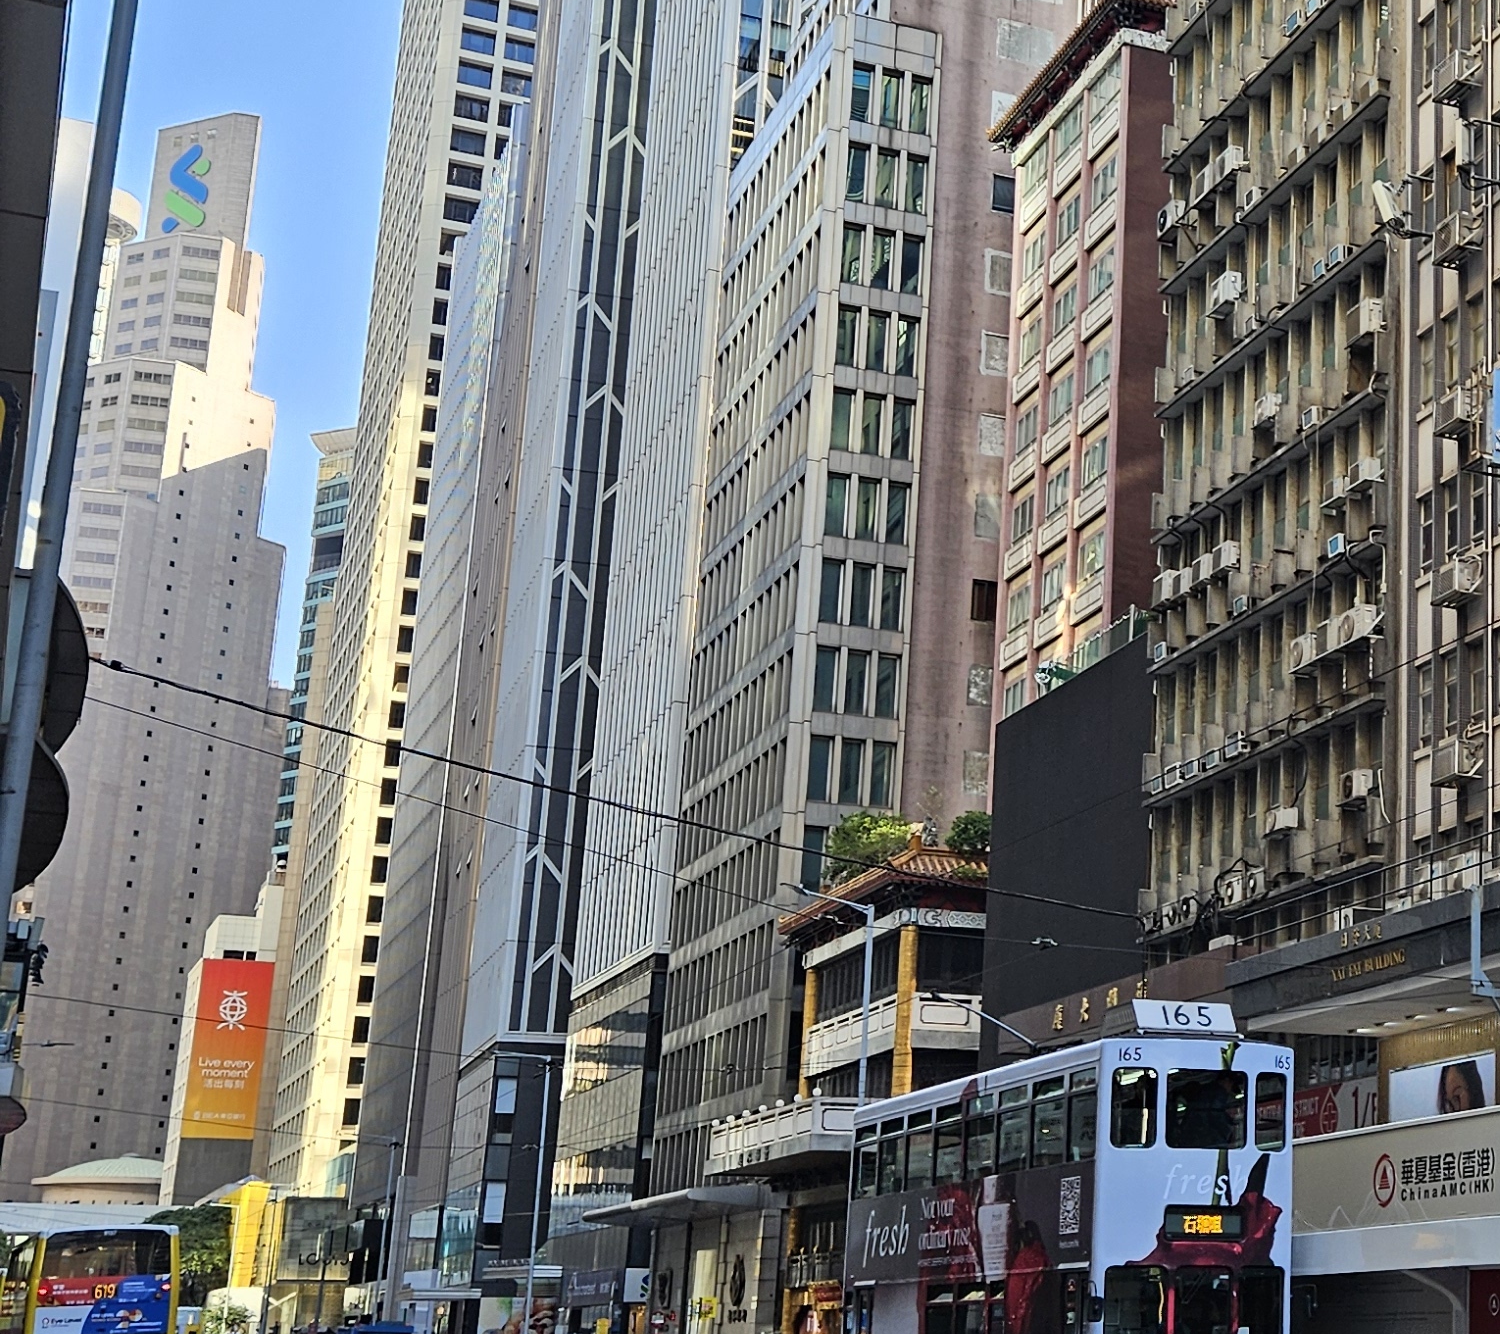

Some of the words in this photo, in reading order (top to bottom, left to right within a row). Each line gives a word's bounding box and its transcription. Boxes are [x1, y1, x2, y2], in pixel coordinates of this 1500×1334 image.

[1364, 948, 1406, 972] BUILDING
[1161, 1005, 1213, 1027] 165
[1118, 1047, 1143, 1062] 165
[1274, 1054, 1291, 1070] 165
[198, 1057, 221, 1067] Live
[223, 1060, 255, 1071] every
[201, 1067, 249, 1078] moment
[1163, 1163, 1248, 1200] fresh
[862, 1205, 910, 1269] fresh
[94, 1283, 116, 1299] 619
